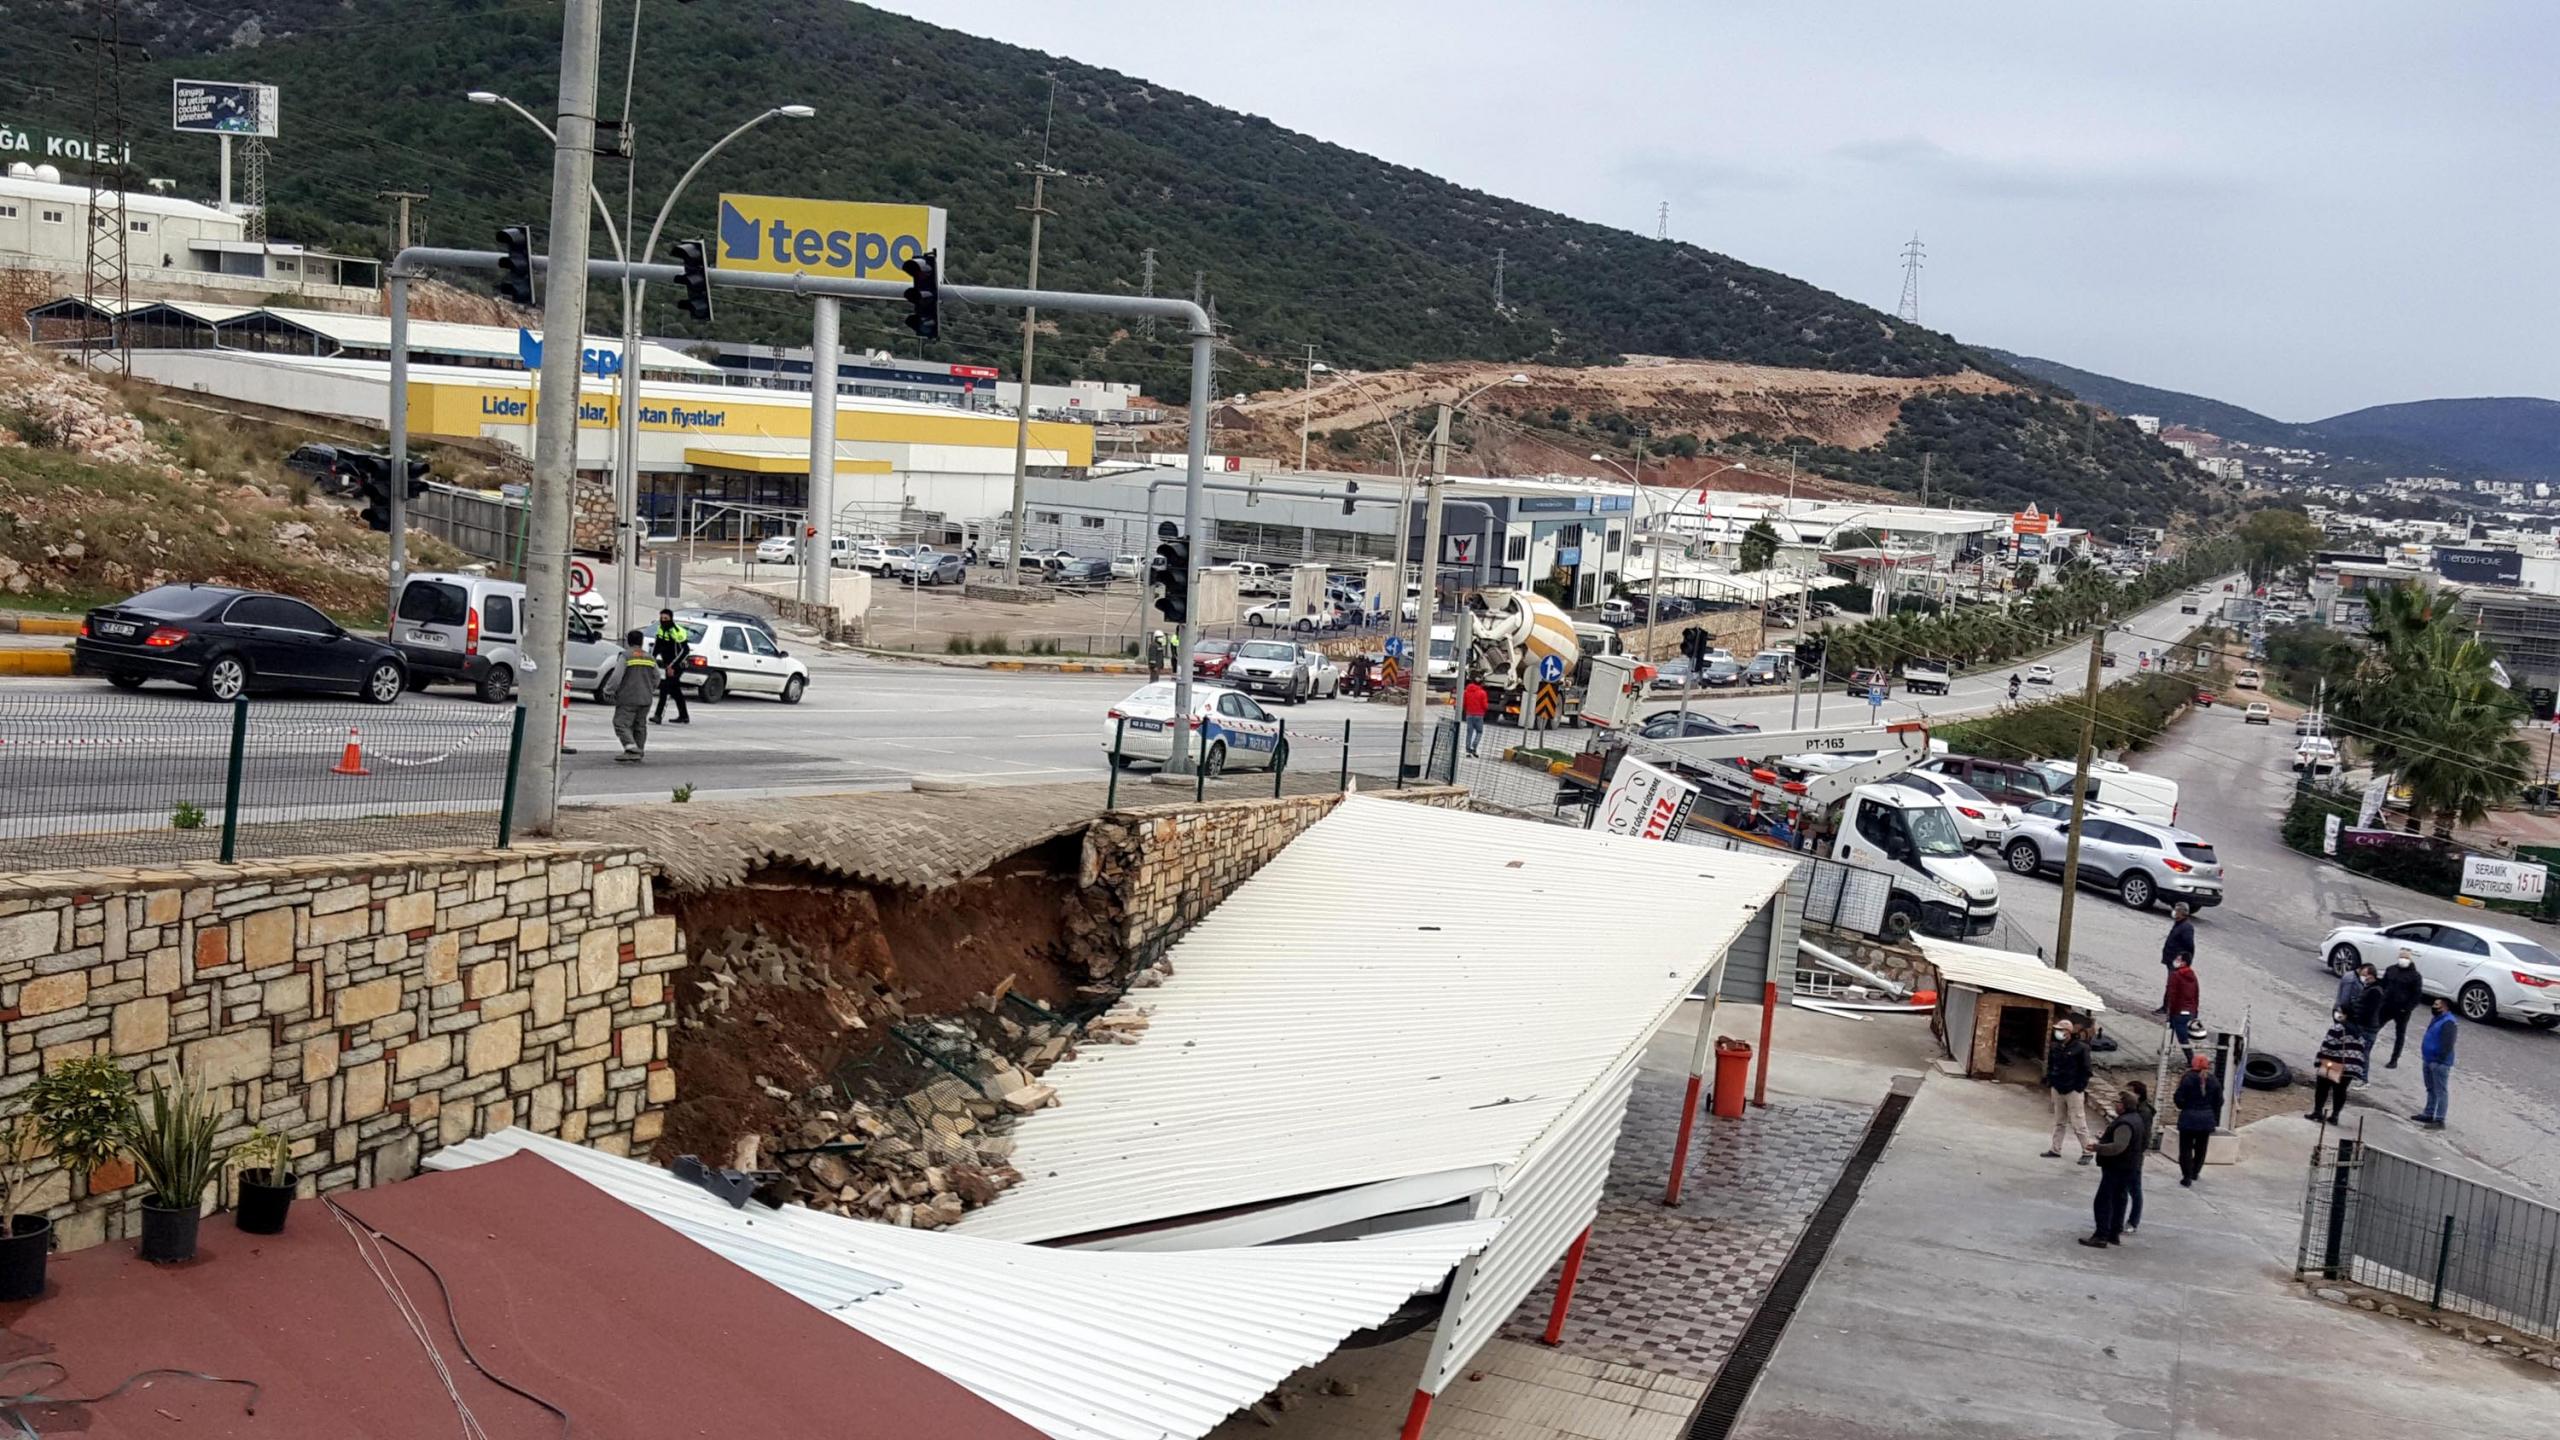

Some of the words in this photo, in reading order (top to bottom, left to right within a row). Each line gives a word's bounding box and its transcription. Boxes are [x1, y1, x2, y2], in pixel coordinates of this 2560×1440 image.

[768, 219, 923, 278] tespo
[482, 395, 527, 417] Lider
[671, 406, 726, 428] fiyatlar!
[1806, 737, 1845, 750] PT-163
[2474, 862, 2508, 877] SERAMİK
[2517, 872, 2528, 892] 15
[2530, 874, 2542, 894] TL
